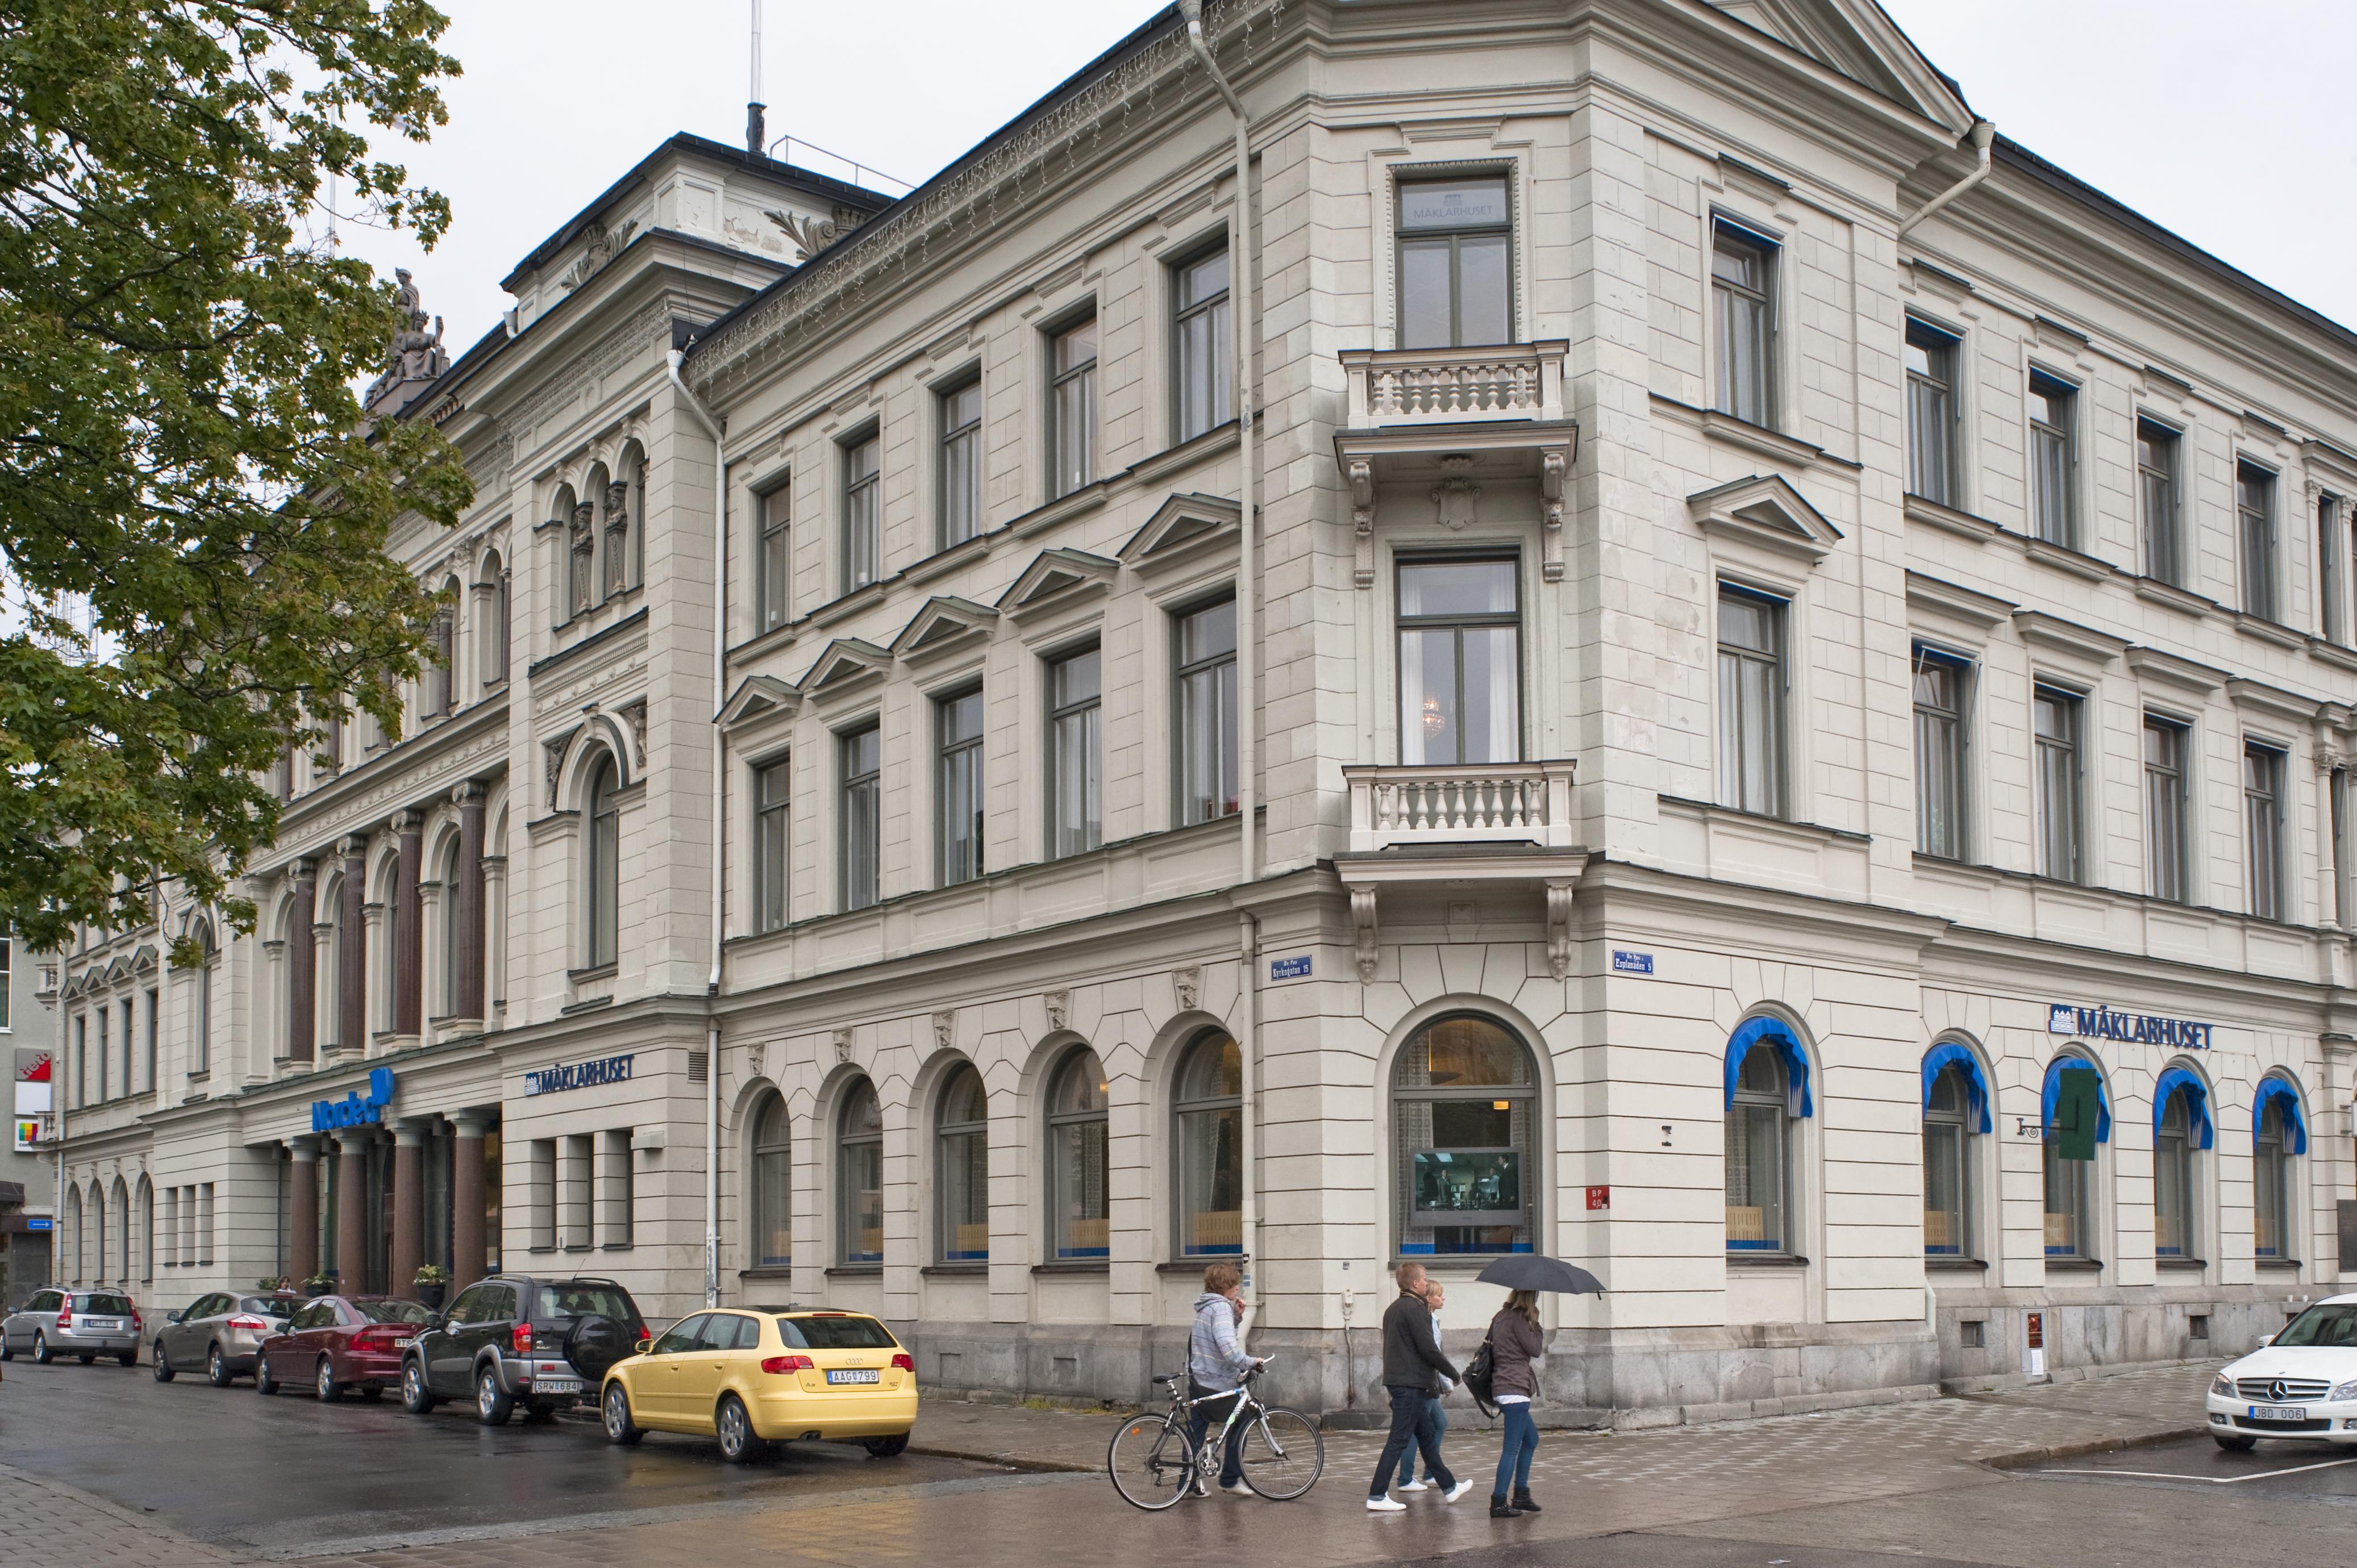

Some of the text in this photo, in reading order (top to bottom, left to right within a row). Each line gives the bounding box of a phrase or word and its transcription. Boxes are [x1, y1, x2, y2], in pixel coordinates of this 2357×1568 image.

[1413, 206, 1493, 219] MÄKLARHUSET
[1615, 958, 1645, 970] Esplanaden
[1273, 967, 1301, 978] Kyrkogatan
[2077, 1005, 2213, 1049] MÄKLARHUSET
[540, 1054, 634, 1093] MÄKLARHUSET
[312, 1091, 381, 1132] Nordea
[834, 1371, 876, 1381] AAG 799
[2255, 1408, 2301, 1419] JBD 006
